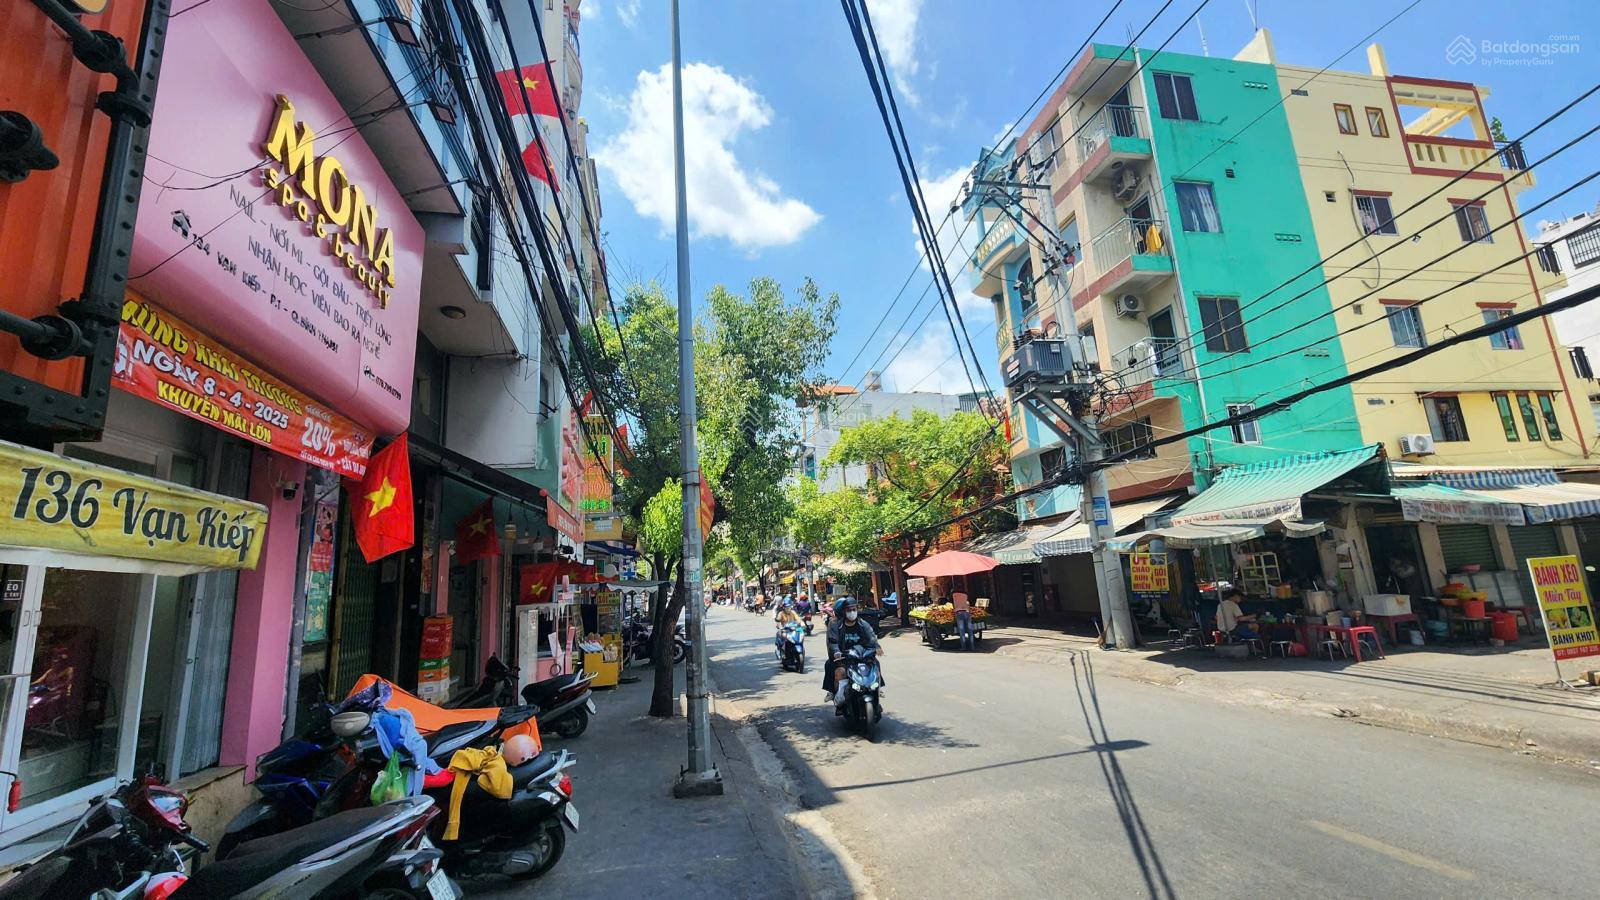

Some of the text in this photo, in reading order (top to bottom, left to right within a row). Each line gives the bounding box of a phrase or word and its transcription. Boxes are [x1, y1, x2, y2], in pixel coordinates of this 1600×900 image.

[230, 184, 256, 224] NAIL
[292, 243, 303, 264] MI
[313, 265, 329, 288] GỘI
[267, 94, 396, 289] MONA
[268, 166, 308, 222] spa
[335, 239, 392, 309] beauty
[249, 236, 281, 276] NHẬN
[285, 267, 307, 296] HỌC
[312, 290, 330, 317] VIÊN
[334, 309, 350, 331] BAO
[351, 325, 361, 343] RA
[133, 340, 200, 385] NGÀY
[203, 377, 216, 396] 8
[229, 391, 243, 408] 4
[255, 401, 289, 430] 2025
[157, 380, 220, 421] KHUYẾN
[250, 422, 272, 443] LỚN
[302, 417, 335, 457] 20%
[12, 466, 257, 563] 136 Vạn Kiếp
[1534, 560, 1579, 586] BÁNH XÈO
[1552, 631, 1575, 646] BÁNH
